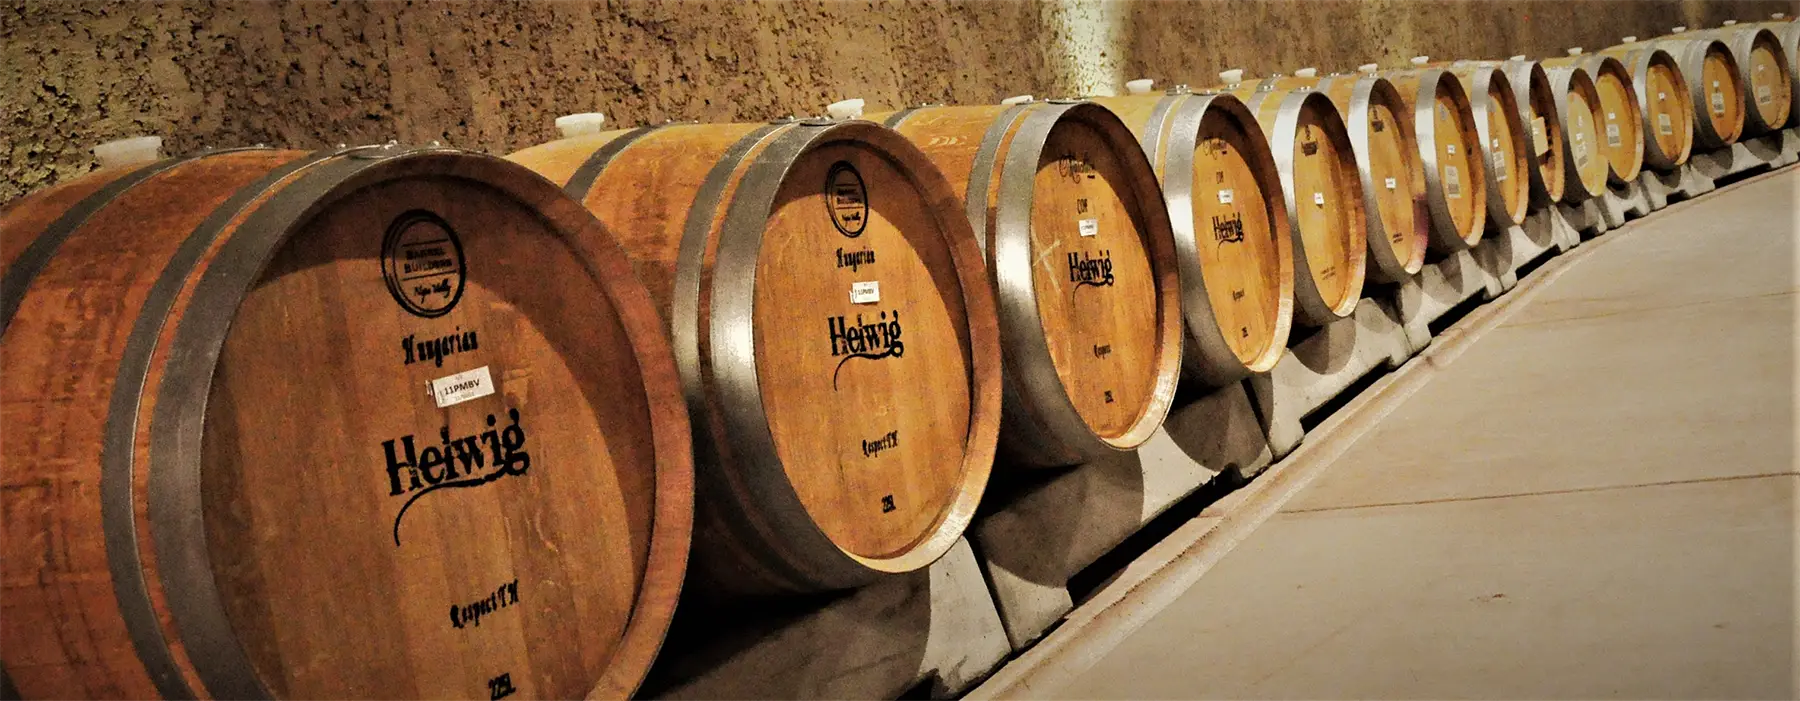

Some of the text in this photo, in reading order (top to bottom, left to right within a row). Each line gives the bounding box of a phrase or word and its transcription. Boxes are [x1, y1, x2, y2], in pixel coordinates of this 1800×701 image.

[402, 325, 479, 368] Hungarian
[444, 378, 480, 396] 11PMBV
[449, 591, 497, 629] Respect
